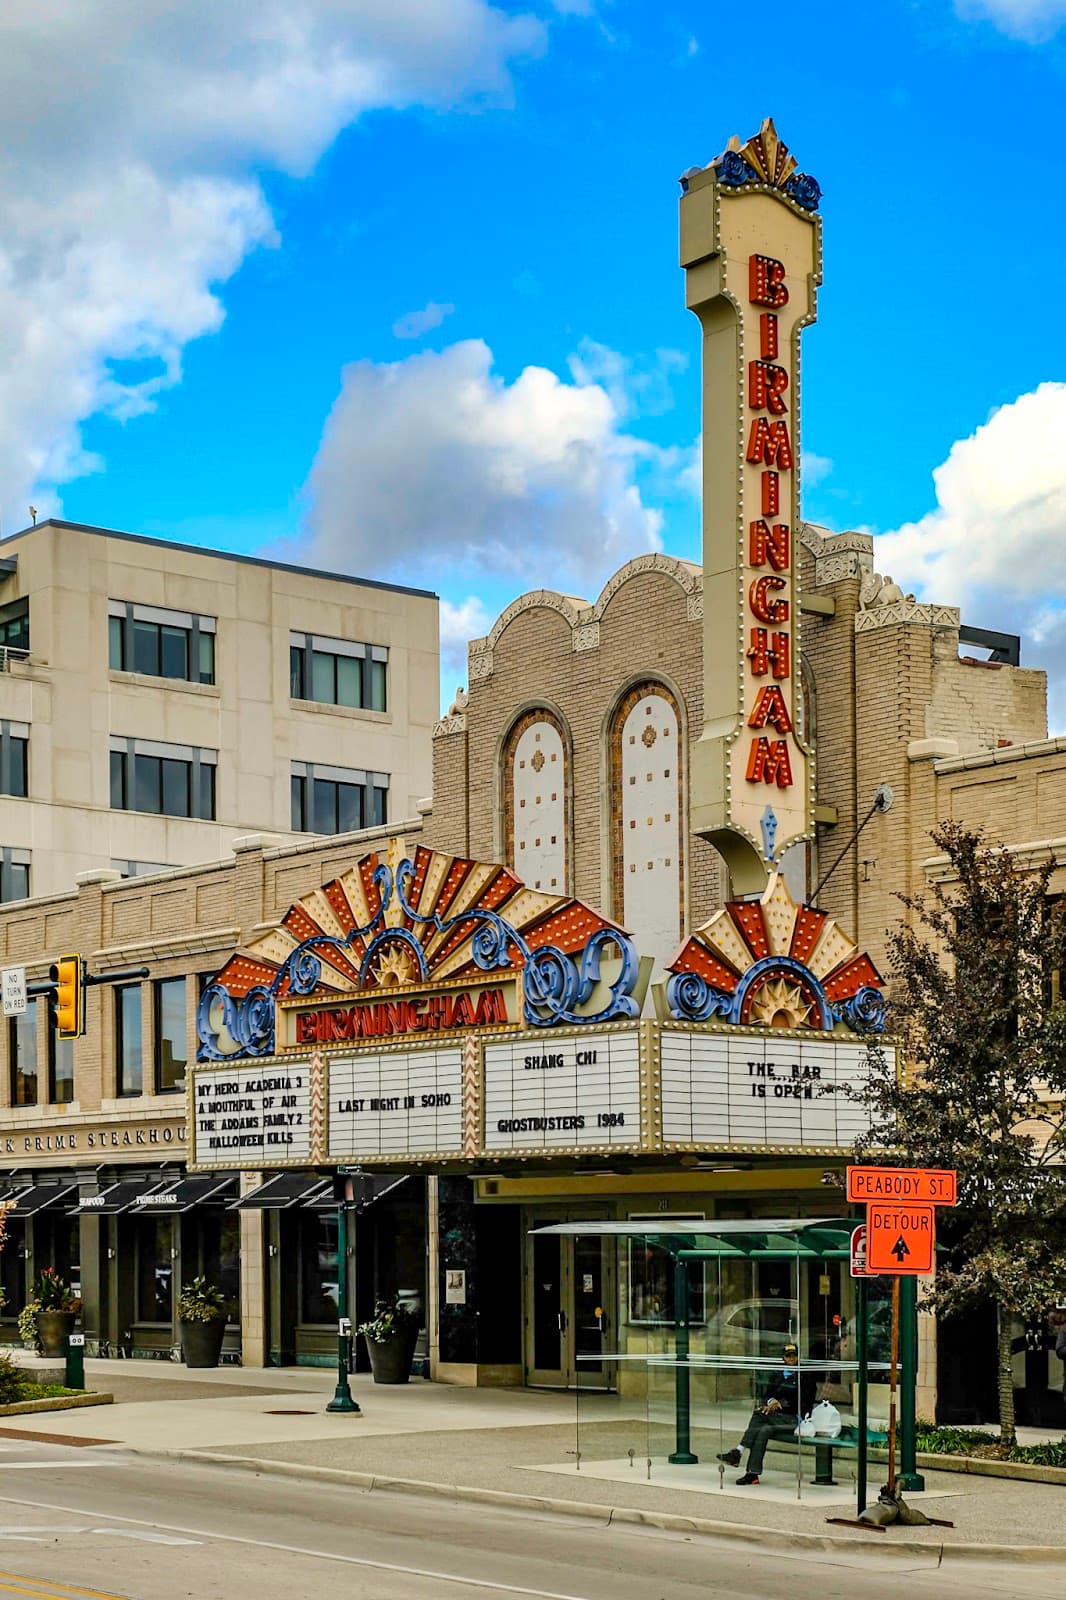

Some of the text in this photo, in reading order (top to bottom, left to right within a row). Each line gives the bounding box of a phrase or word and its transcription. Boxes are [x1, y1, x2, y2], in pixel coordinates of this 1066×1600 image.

[745, 253, 793, 788] BIRMINGHAM
[8, 974, 18, 983] NO
[7, 987, 21, 997] TURN
[13, 998, 24, 1008] RED
[296, 989, 508, 1043] BIRMINGHAM
[524, 1050, 597, 1069] SHANG CHI
[747, 1062, 821, 1080] THE BAR
[198, 1076, 302, 1096] MY HERO ACADEMIA 3
[751, 1083, 812, 1099] IS OPEN
[199, 1095, 297, 1114] A MOUTHFUL OF AIR
[338, 1093, 451, 1113] LAST NIGHT IN SOHO
[200, 1113, 303, 1131] THE ADDAMS FAMILY 2
[497, 1112, 625, 1133] GHOSTBUSTERS 1984
[0, 1139, 15, 1153] K
[24, 1135, 76, 1151] PRIME
[209, 1131, 293, 1148] HALLOWEEN KILLS
[856, 1175, 949, 1196] PEABODY ST.
[873, 1214, 929, 1231] DETOUR
